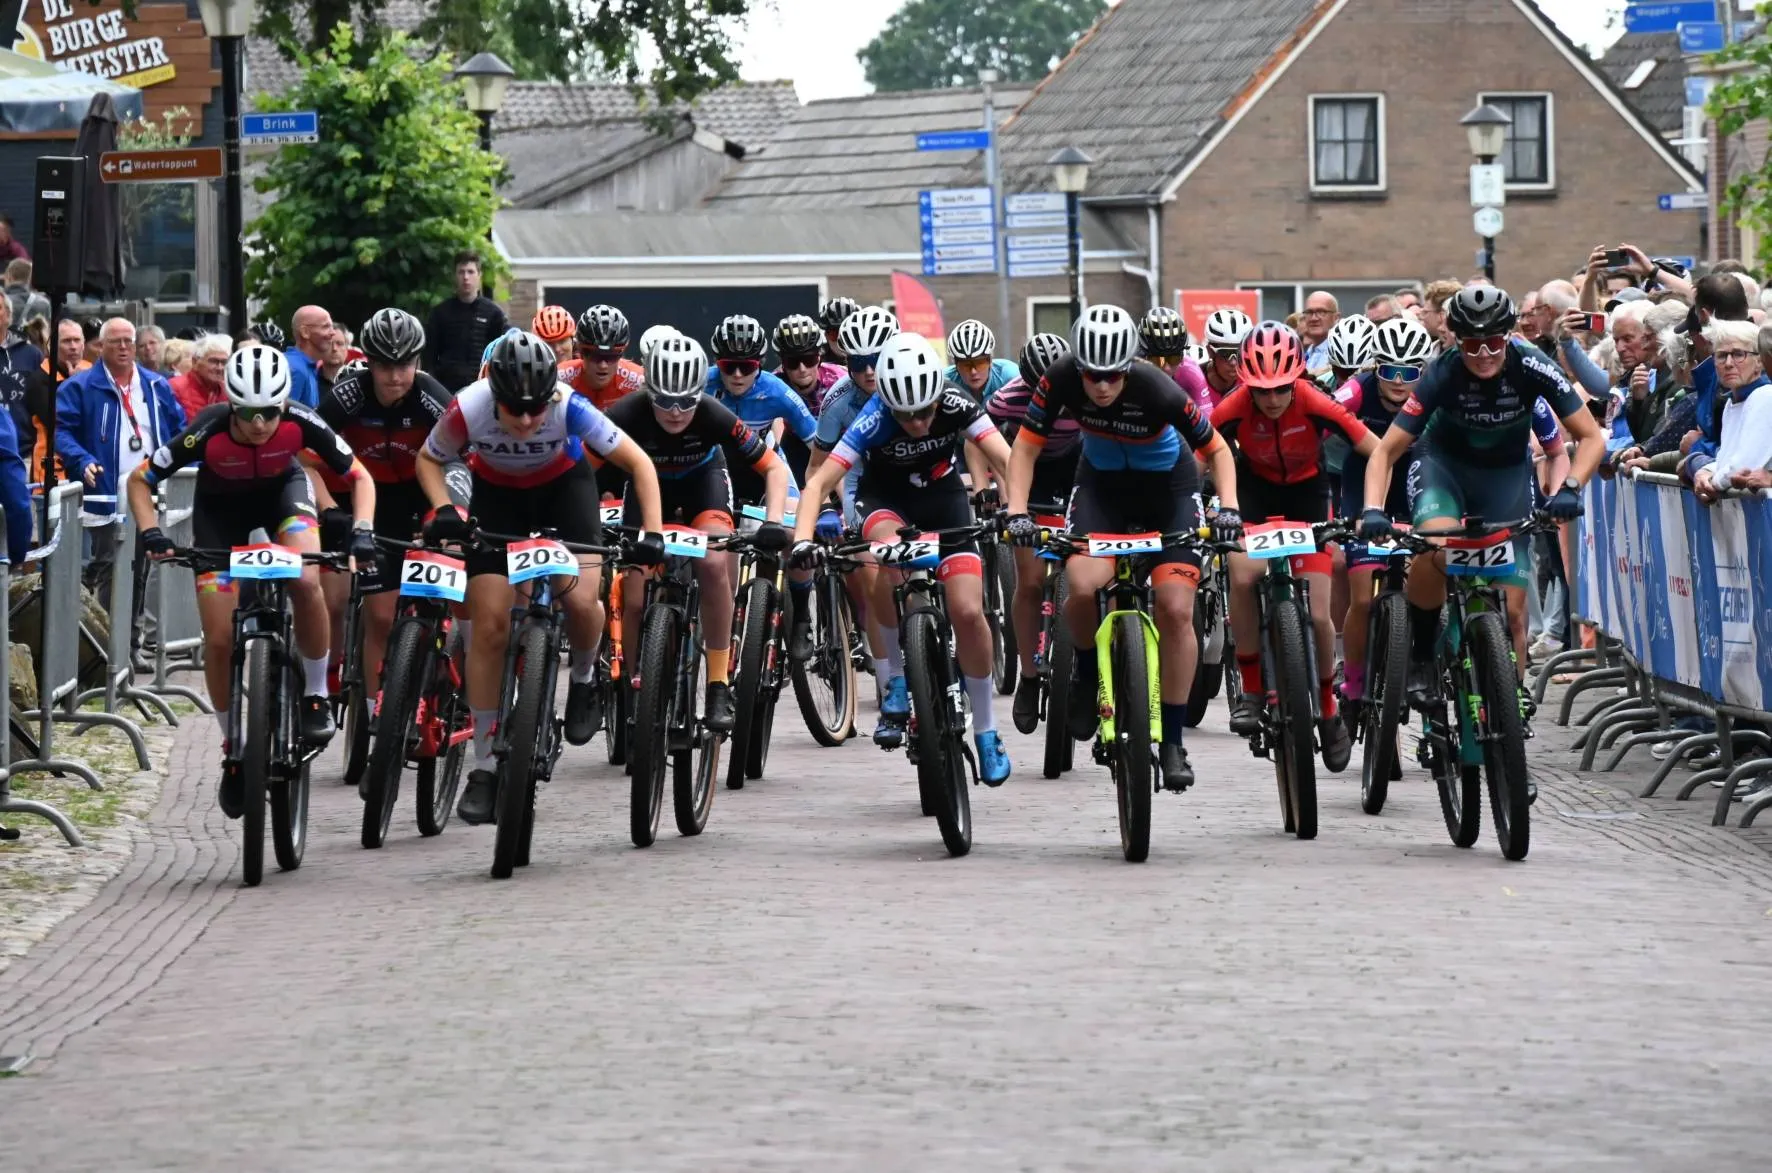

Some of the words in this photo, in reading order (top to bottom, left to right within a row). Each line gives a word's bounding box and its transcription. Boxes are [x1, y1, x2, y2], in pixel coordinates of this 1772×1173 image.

[47, 9, 128, 56] BURGE
[262, 117, 296, 130] Brink
[133, 159, 198, 170] Watertappunt
[665, 531, 700, 546] 14
[1252, 530, 1307, 551] 219
[514, 548, 570, 572] 209
[1451, 545, 1508, 567] 212
[406, 562, 457, 588] 201
